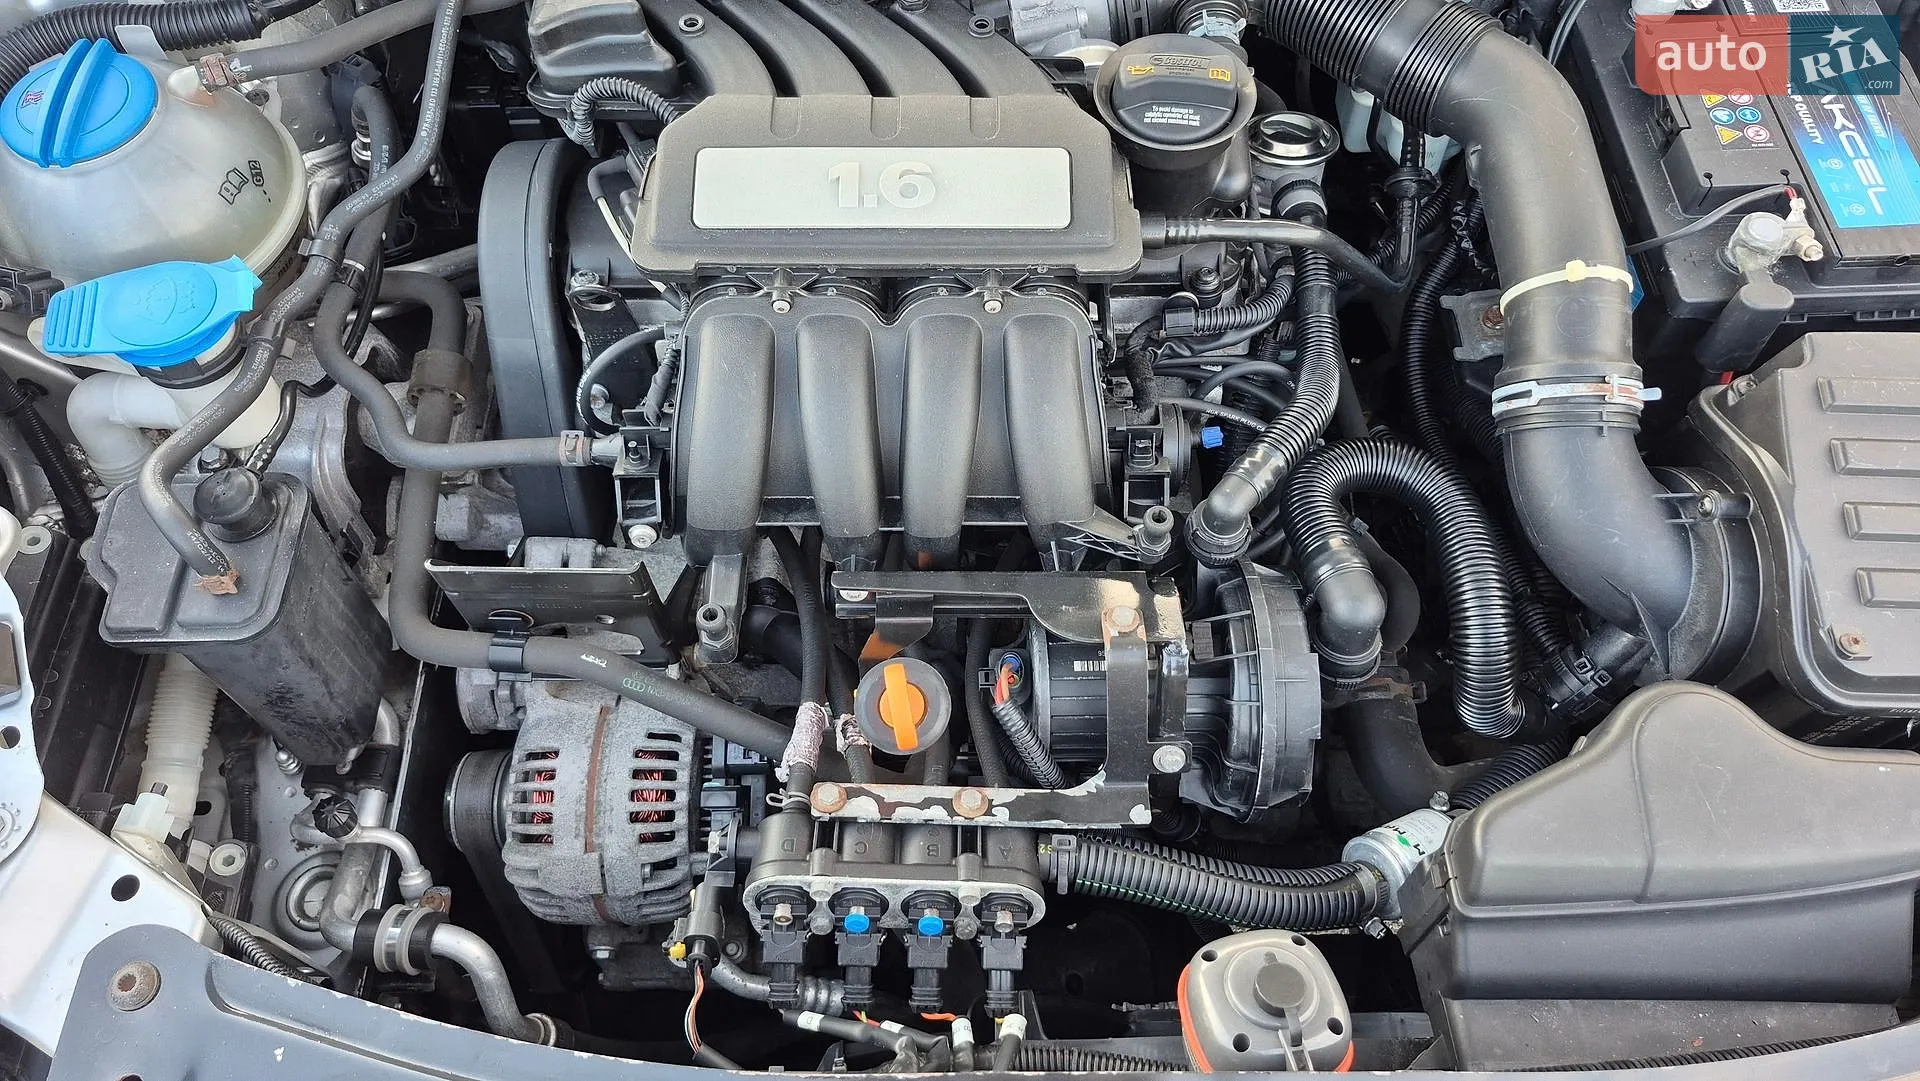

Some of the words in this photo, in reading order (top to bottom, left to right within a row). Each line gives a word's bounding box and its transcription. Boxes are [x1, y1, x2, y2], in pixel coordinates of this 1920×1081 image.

[1795, 103, 1825, 145] QUALITY
[249, 161, 264, 186] G12
[828, 161, 935, 208] 1.6
[1220, 411, 1240, 421] SPARK
[1240, 417, 1257, 428] PLUG
[781, 839, 797, 853] D
[853, 842, 869, 856] C
[926, 843, 941, 857] B
